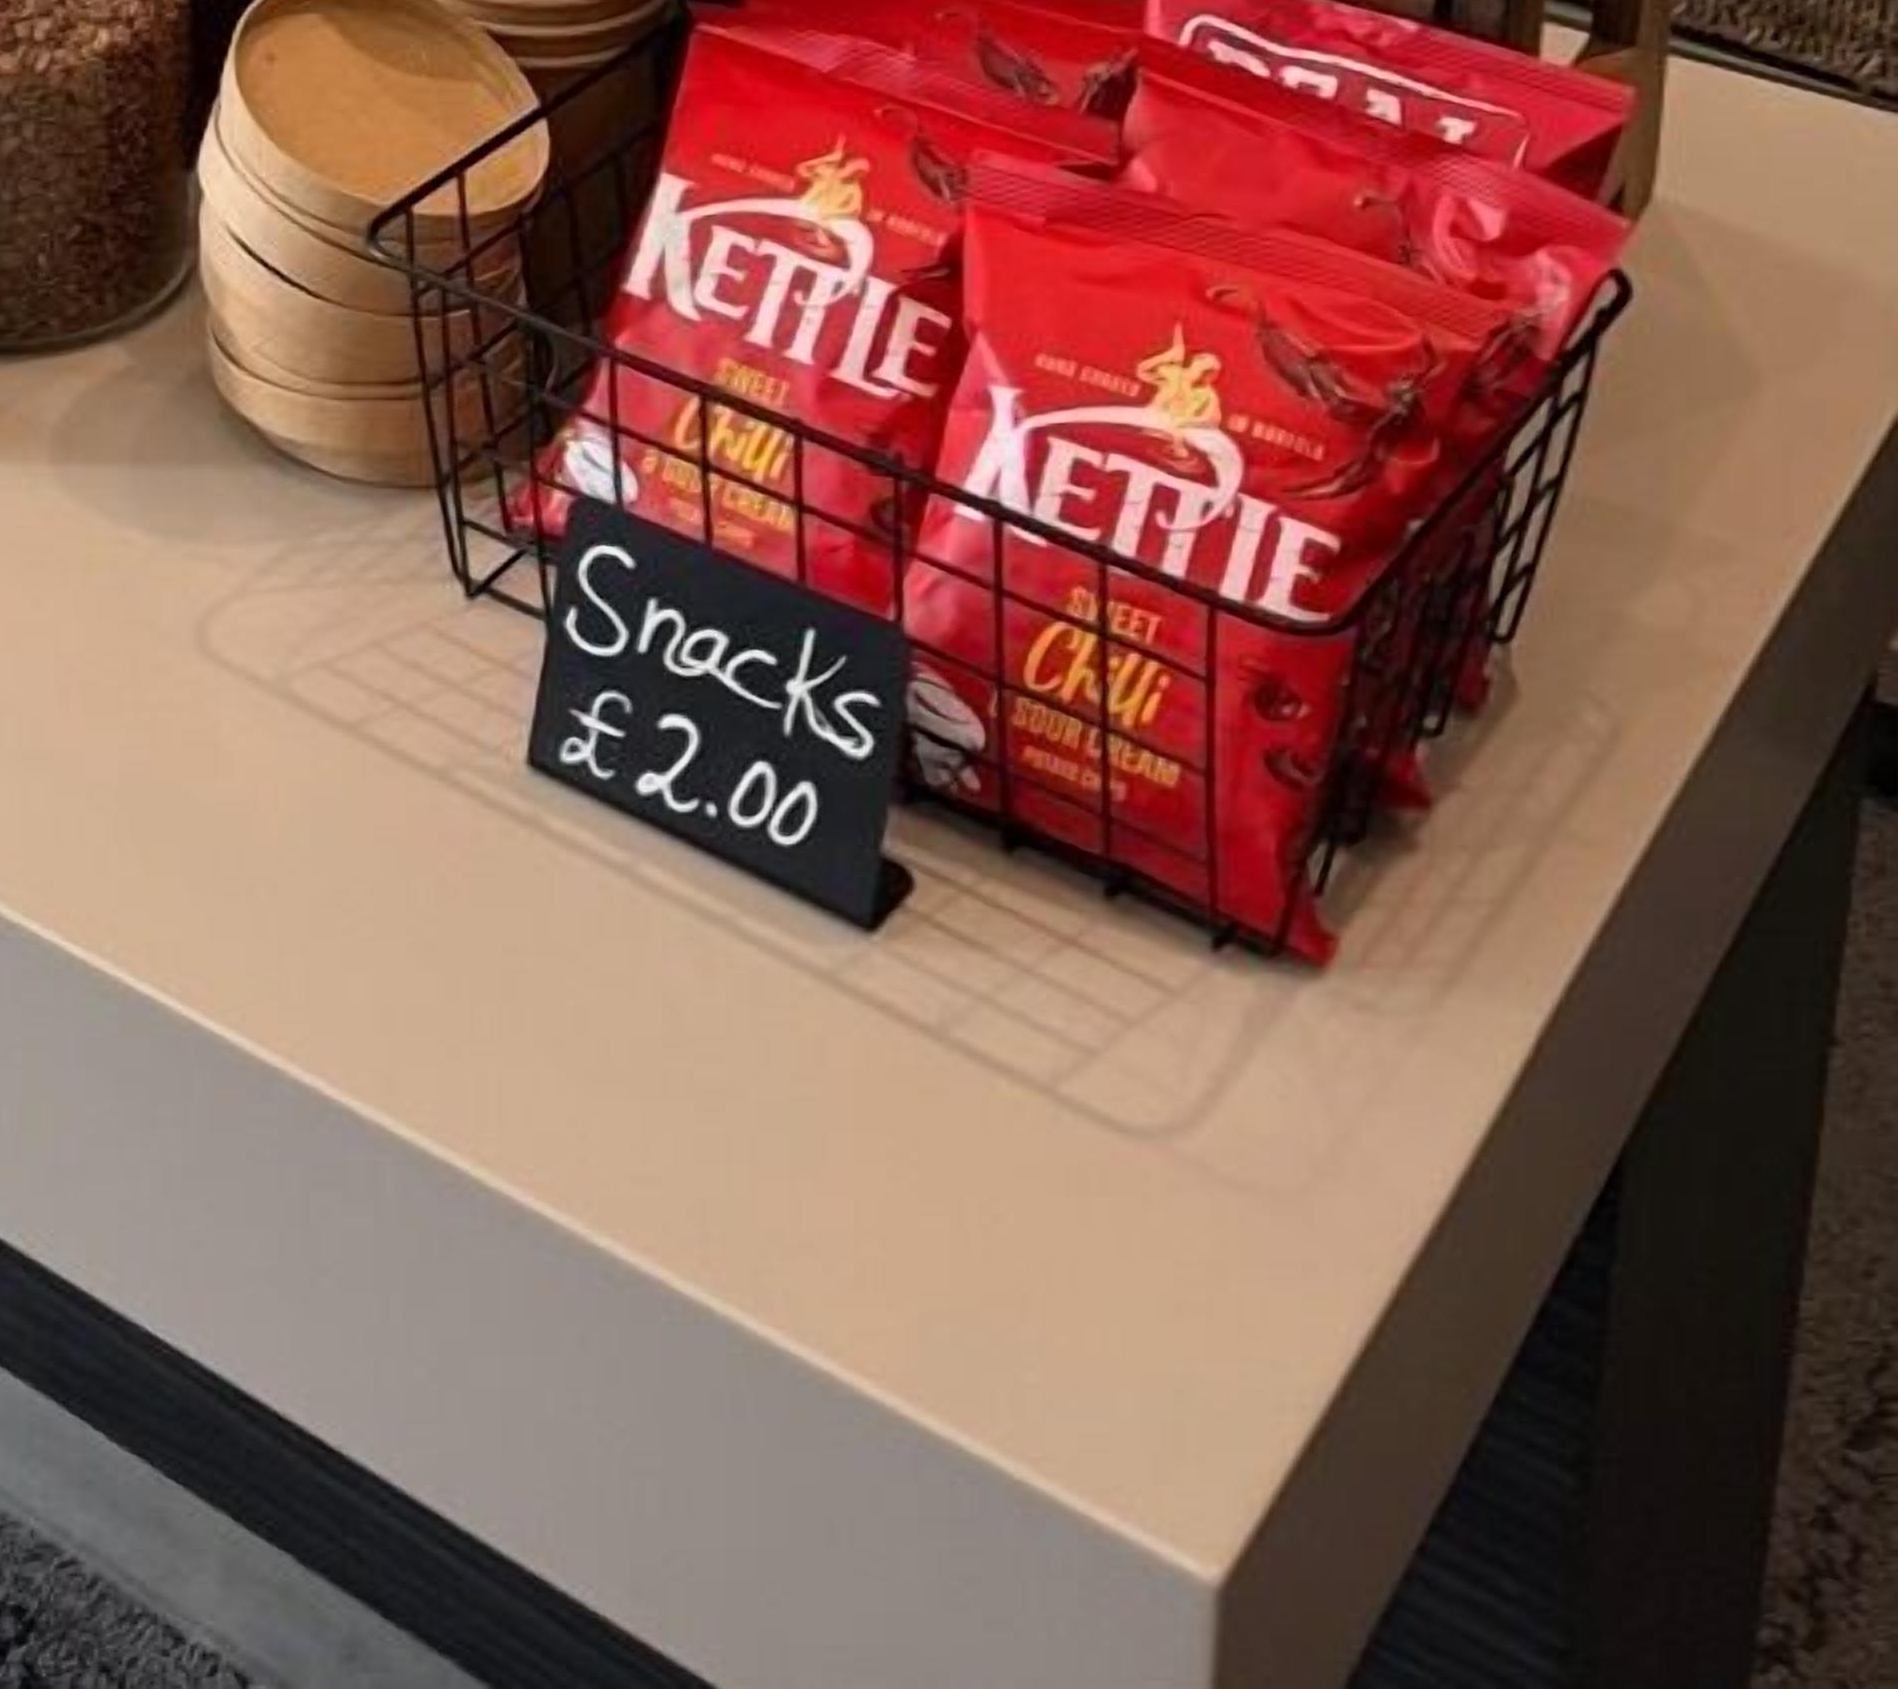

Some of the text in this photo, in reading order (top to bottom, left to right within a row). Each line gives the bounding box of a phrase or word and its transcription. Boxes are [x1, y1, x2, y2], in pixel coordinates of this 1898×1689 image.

[622, 173, 952, 399] KETTLE
[564, 545, 881, 760] Snacks
[557, 691, 819, 847] £2.00
